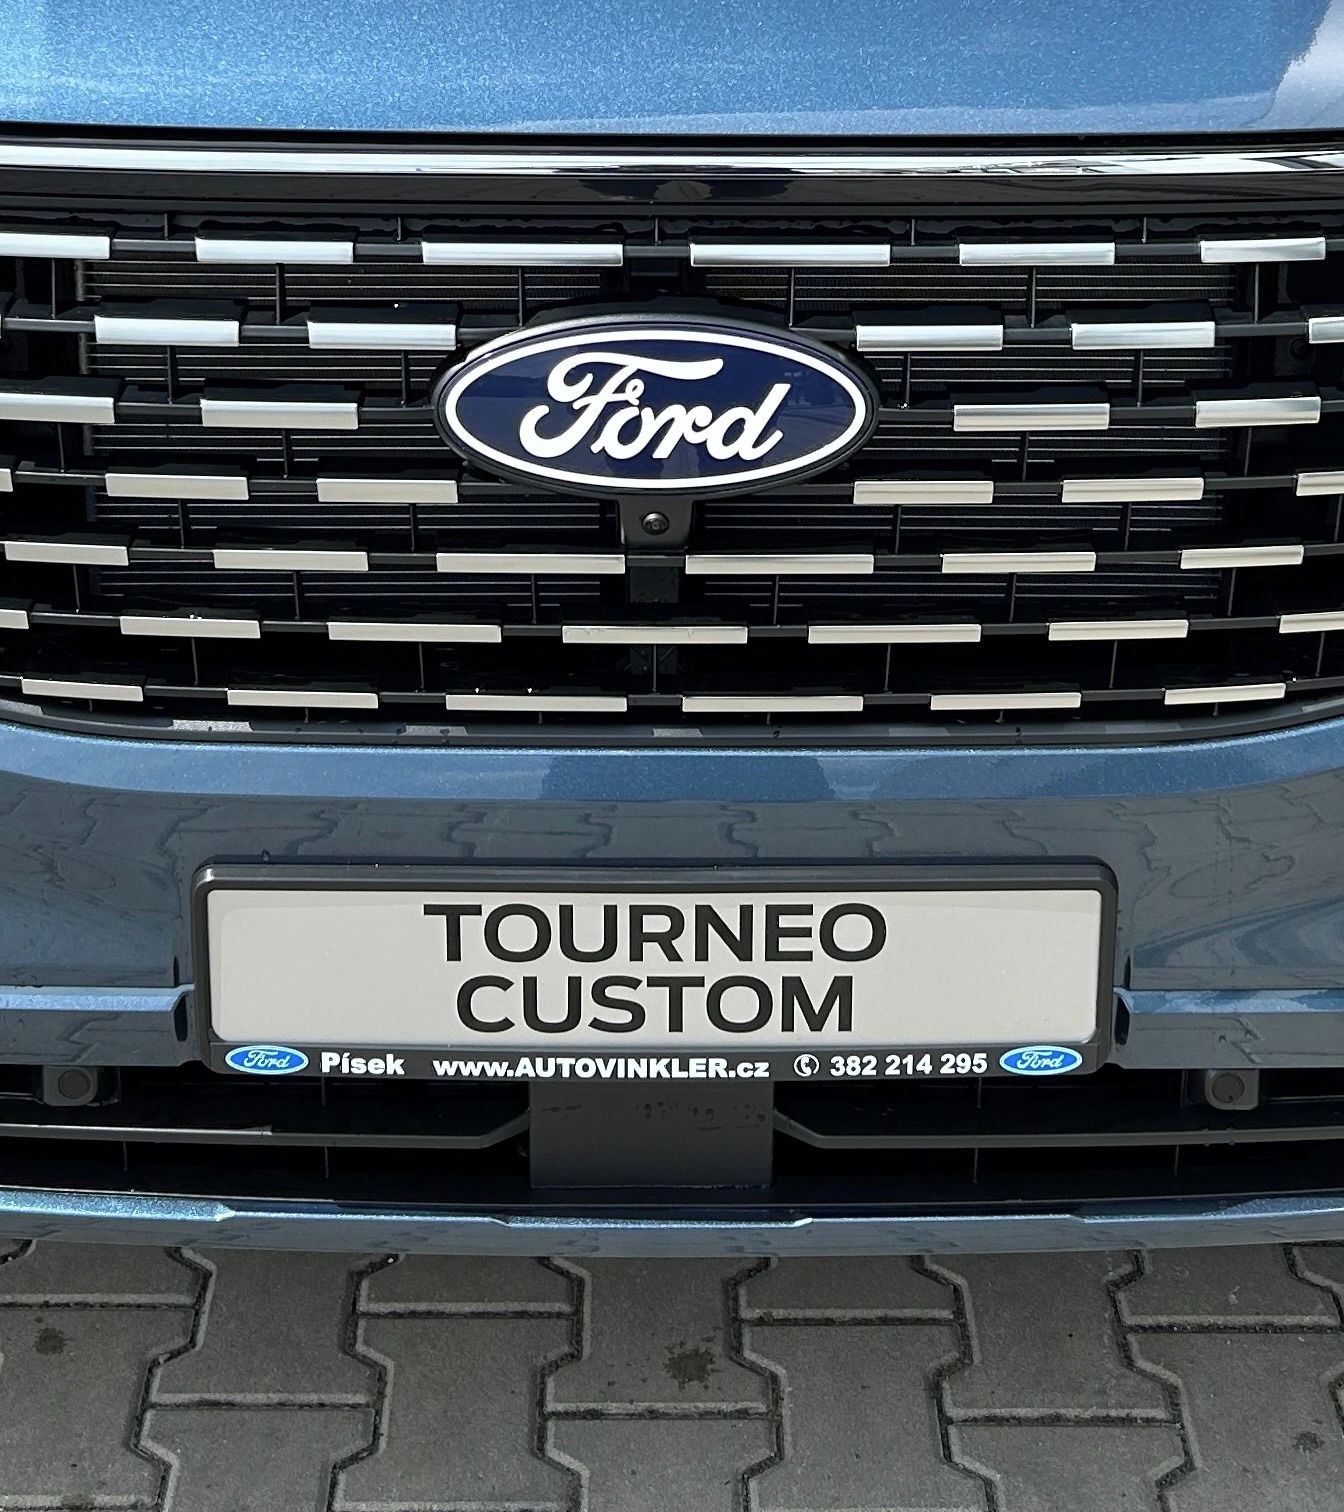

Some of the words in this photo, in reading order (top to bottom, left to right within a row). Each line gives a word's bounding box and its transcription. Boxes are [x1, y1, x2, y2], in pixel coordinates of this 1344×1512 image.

[519, 351, 792, 462] Ford
[423, 903, 887, 963] TOURNEO
[456, 974, 854, 1034] CUSTOM
[242, 1049, 292, 1069] Ford
[320, 1051, 405, 1076] Písek
[432, 1055, 771, 1079] www.AUTOVINKLER.cz
[829, 1053, 878, 1078] 382
[885, 1053, 933, 1077] 214
[939, 1052, 989, 1076] 295
[1016, 1050, 1065, 1070] Ford
